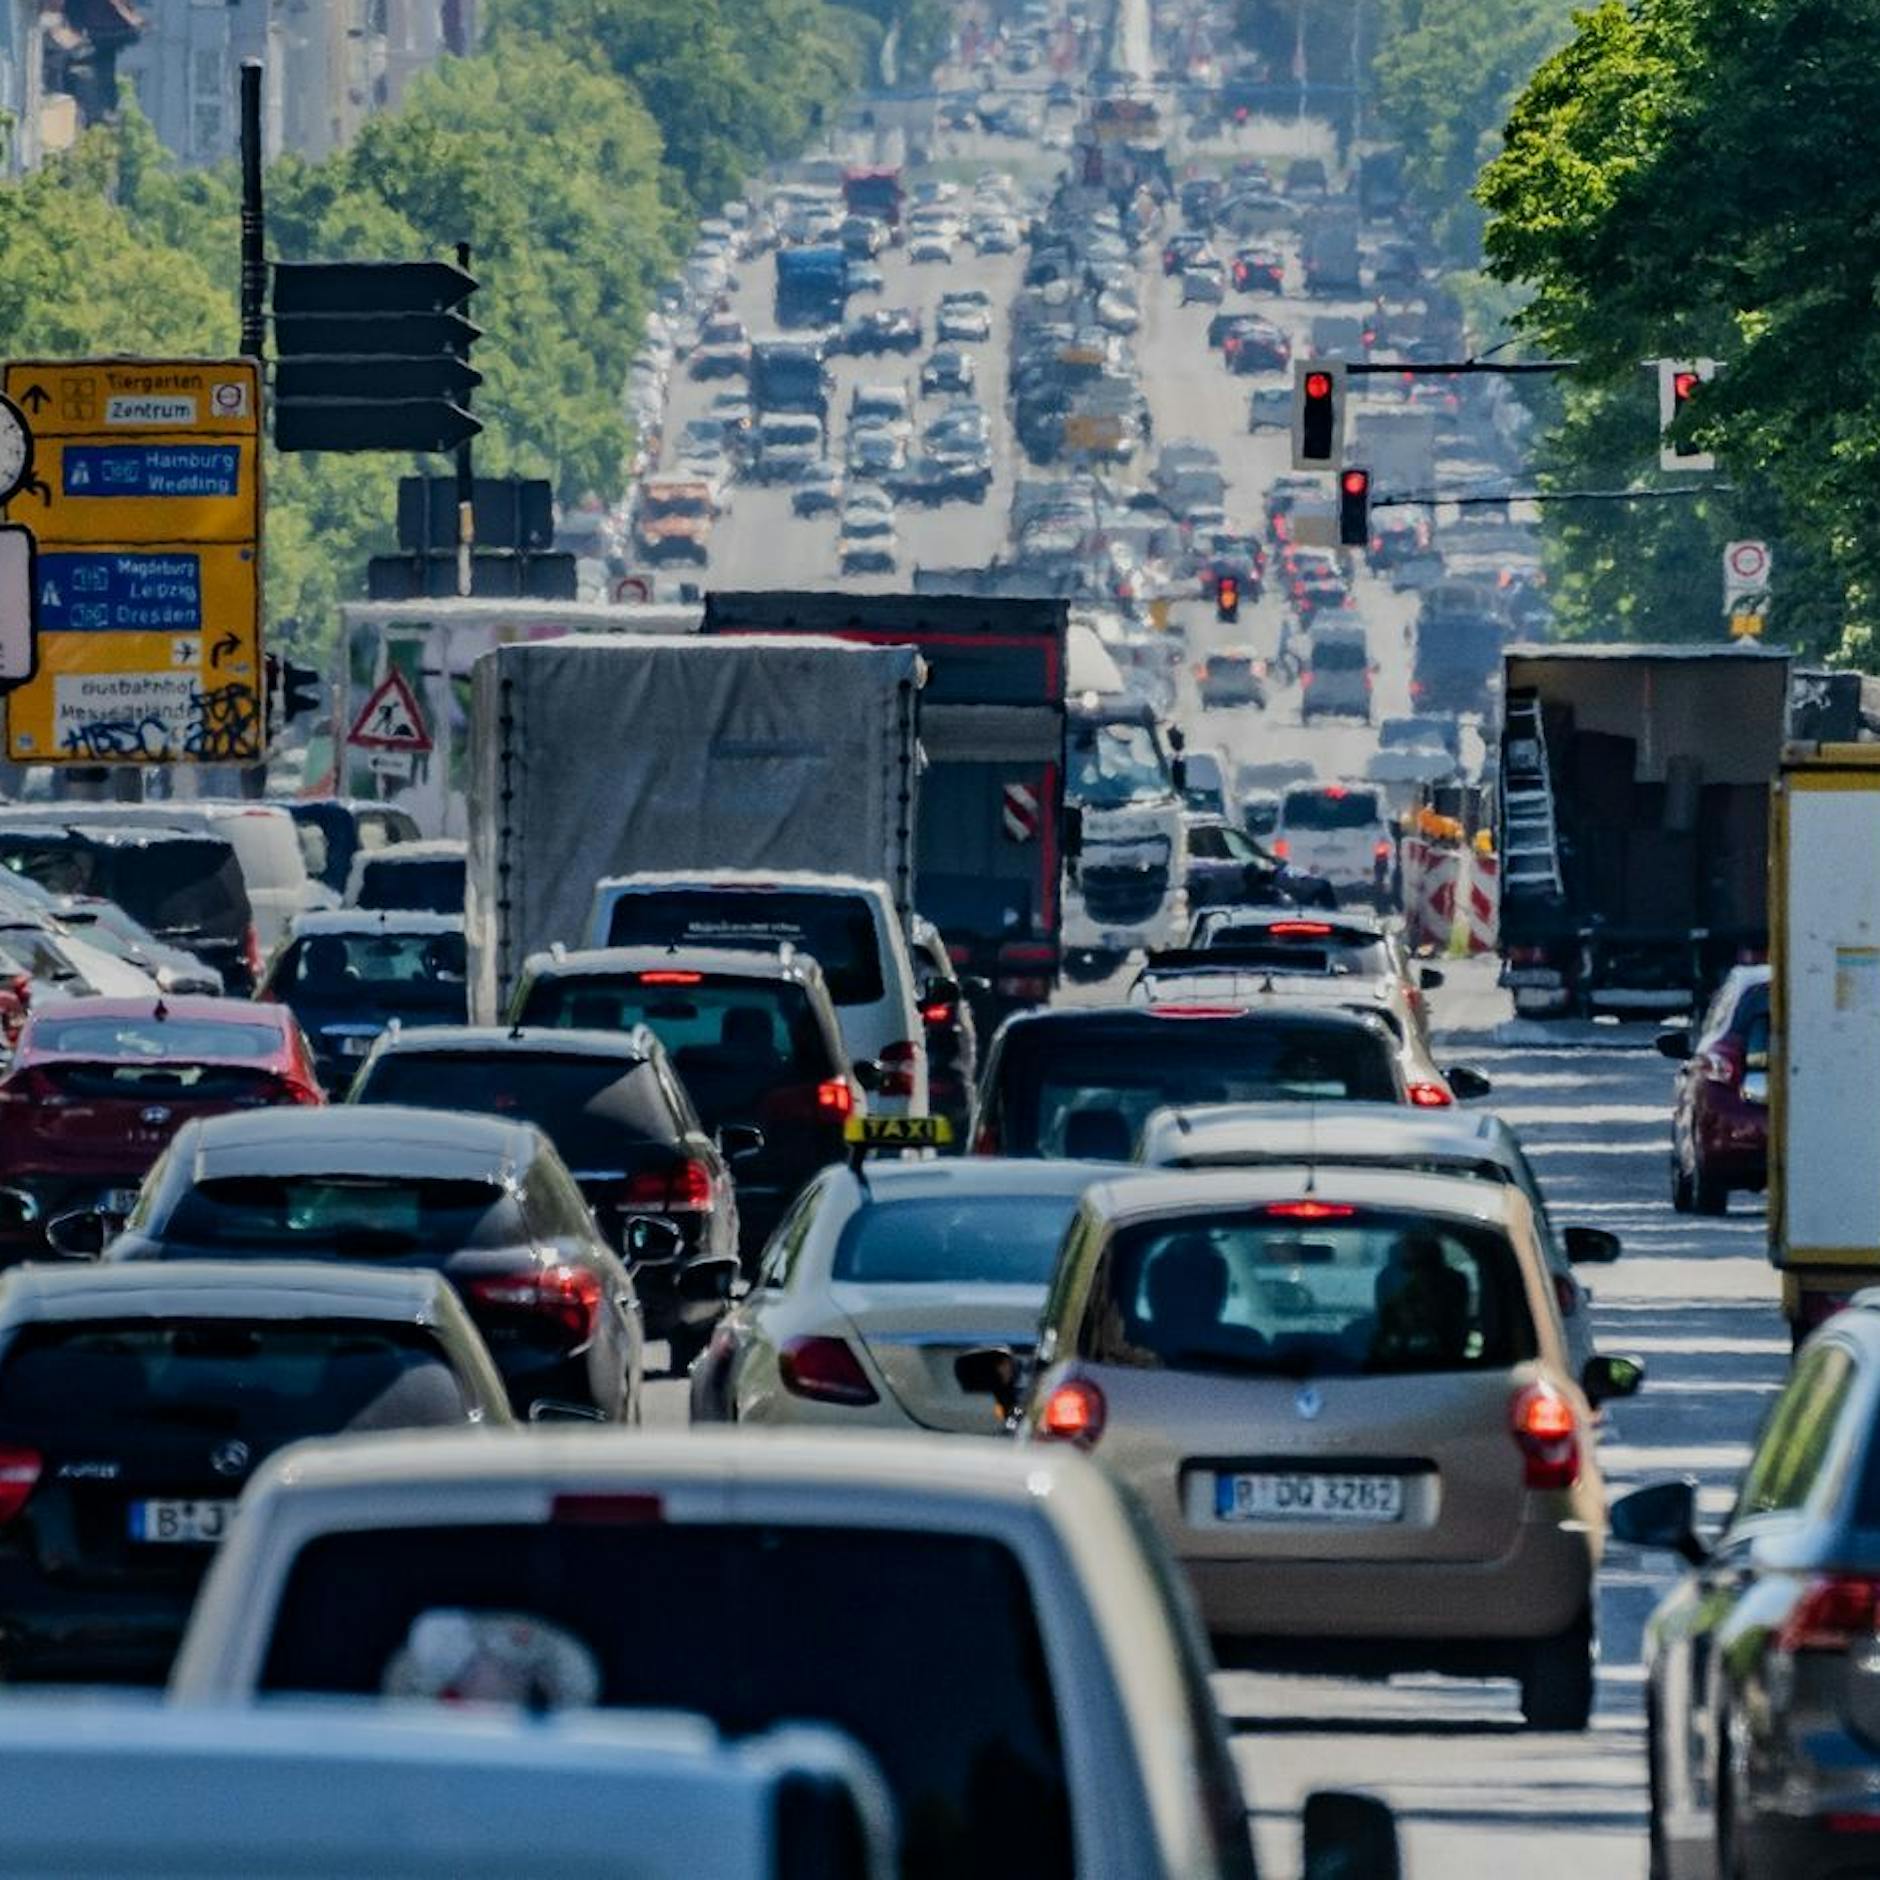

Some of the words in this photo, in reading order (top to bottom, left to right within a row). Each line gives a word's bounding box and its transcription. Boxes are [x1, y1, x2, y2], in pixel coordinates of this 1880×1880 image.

[106, 373, 202, 393] Tiergarten
[111, 401, 191, 419] Zentrum
[146, 451, 234, 472] Hamburg
[148, 474, 230, 493] Wedding
[117, 559, 195, 578] Magdeburg
[130, 582, 197, 602] Leipzig
[117, 605, 197, 624] Dresden
[867, 1118, 934, 1138] TAXI
[158, 1507, 178, 1537] B
